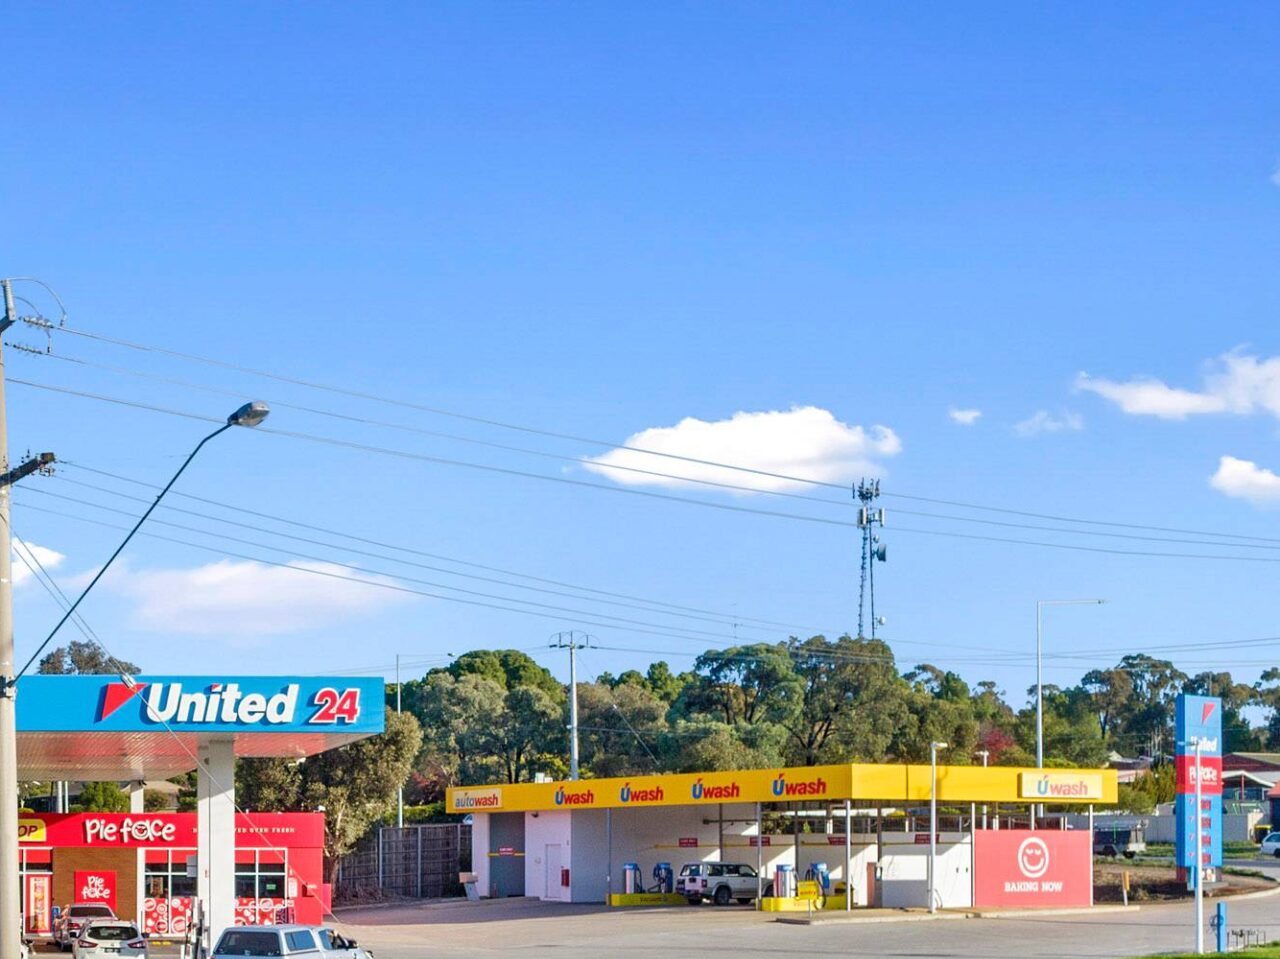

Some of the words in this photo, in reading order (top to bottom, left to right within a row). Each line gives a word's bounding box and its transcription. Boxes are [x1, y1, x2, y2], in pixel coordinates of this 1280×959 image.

[146, 683, 300, 723] United
[309, 688, 360, 723] 24
[1004, 882, 1038, 892] BAKING
[1041, 882, 1063, 892] NOW
